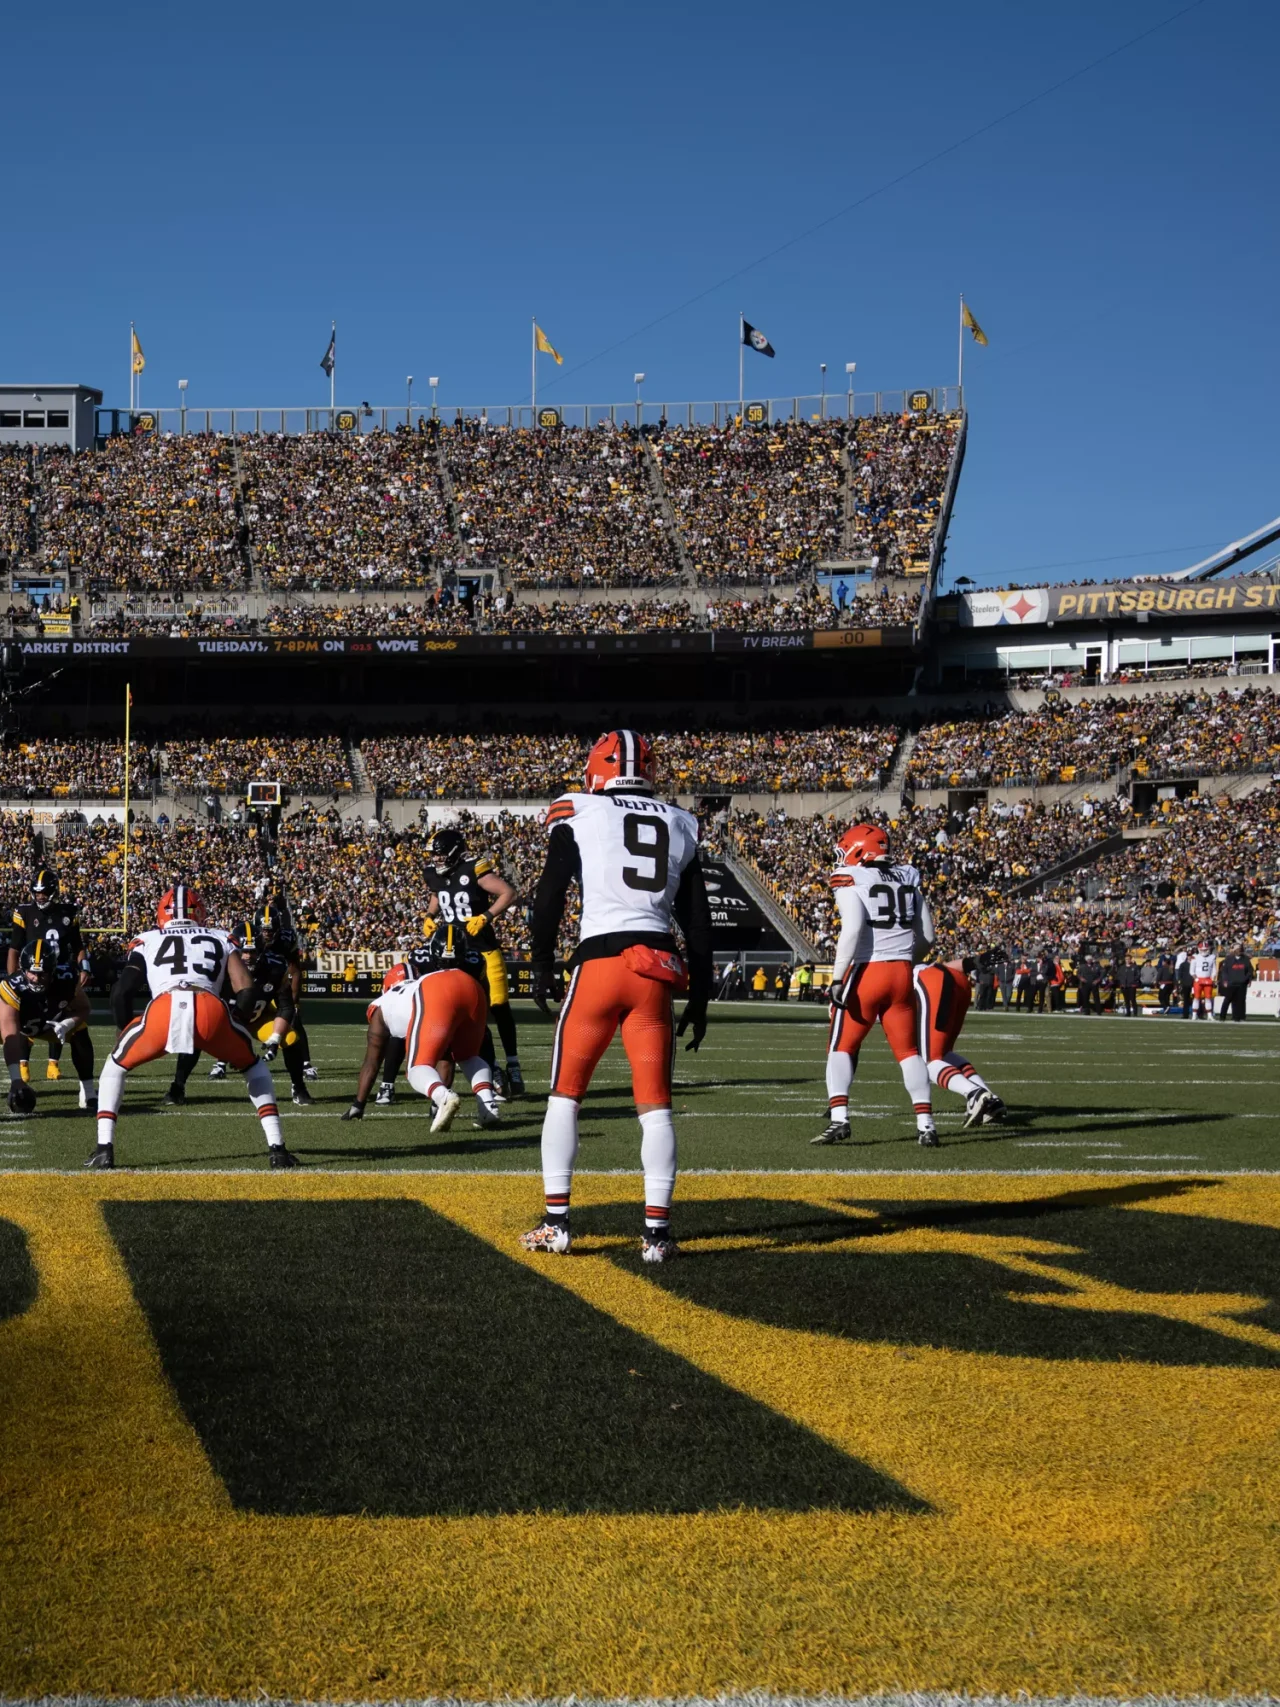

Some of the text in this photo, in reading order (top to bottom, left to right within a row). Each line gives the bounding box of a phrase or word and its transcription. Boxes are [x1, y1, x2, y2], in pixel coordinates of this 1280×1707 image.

[911, 397, 928, 409] 518
[339, 416, 353, 428] 521
[540, 414, 557, 426] 520
[748, 410, 762, 422] 519
[1057, 587, 1237, 616] PITTSBURGH
[970, 604, 1000, 615] Steelers
[742, 635, 806, 648] TV BREAK
[839, 632, 864, 645] :00
[16, 643, 69, 654] ARKET
[73, 643, 130, 654] DISTRICT
[197, 641, 269, 653] TUESDAYS,
[273, 640, 320, 652] 7-8PM
[323, 641, 345, 652] ON
[376, 640, 419, 652] WDVE
[423, 640, 459, 651] Rocks
[259, 785, 275, 801] 12
[611, 796, 667, 813] DELPIT
[622, 813, 670, 893] 9
[438, 890, 473, 922] 88
[867, 884, 915, 930] 30
[153, 935, 224, 982] 43
[1201, 961, 1210, 972] 2
[518, 970, 530, 980] 92
[331, 984, 342, 993] 62
[370, 984, 382, 993] 37
[518, 984, 530, 993] 72
